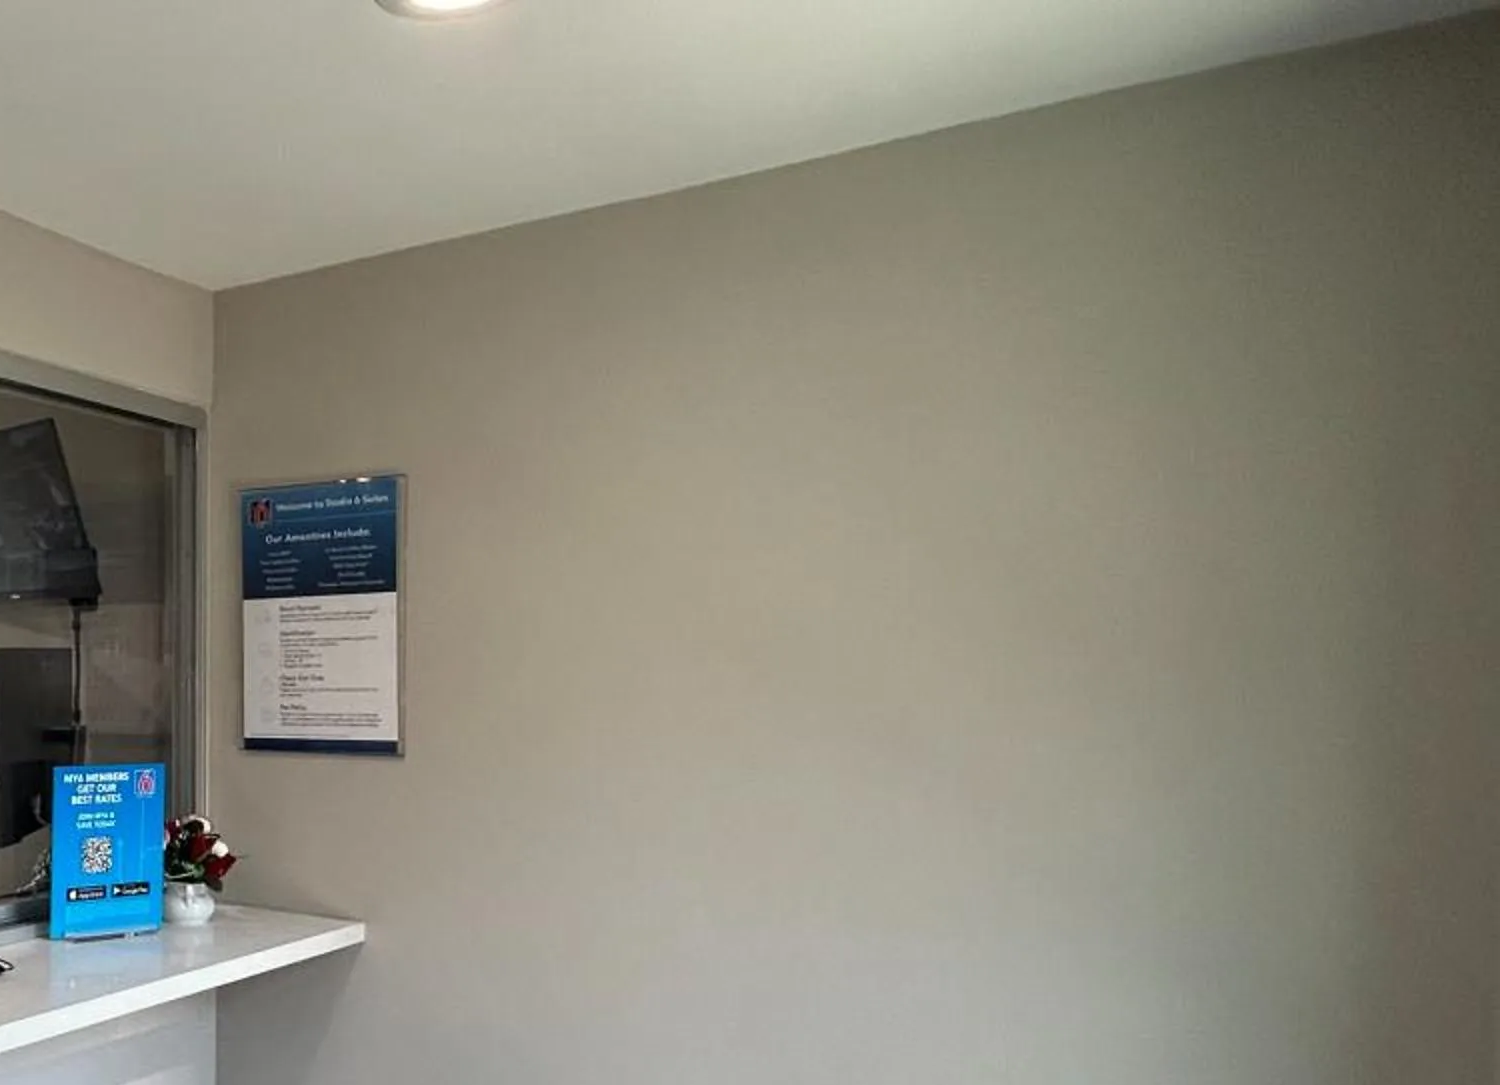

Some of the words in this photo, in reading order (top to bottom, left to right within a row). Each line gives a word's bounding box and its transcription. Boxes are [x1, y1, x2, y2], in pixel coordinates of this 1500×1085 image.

[265, 534, 282, 545] Our
[86, 771, 130, 782] MEMBERS
[77, 784, 95, 794] GET
[96, 783, 117, 793] OUR
[71, 795, 92, 805] BEST
[94, 793, 123, 804] RATES
